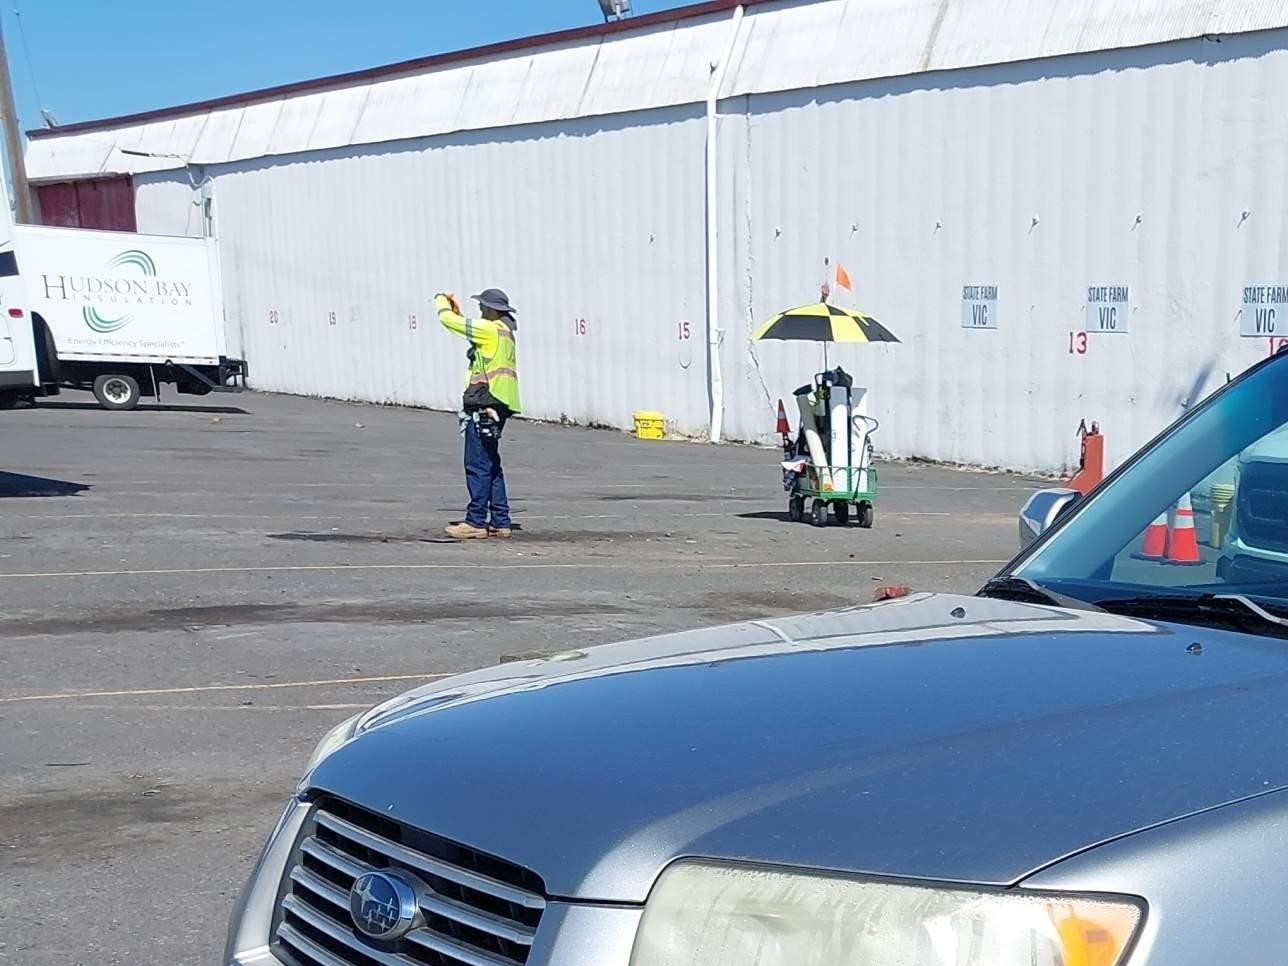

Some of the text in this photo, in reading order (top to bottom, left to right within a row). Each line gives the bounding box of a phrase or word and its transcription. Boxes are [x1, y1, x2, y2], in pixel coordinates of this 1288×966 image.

[41, 274, 191, 299] HUDSON BAY
[963, 285, 998, 300] STATE FARM
[1088, 286, 1128, 302] STATE FARM
[1243, 286, 1288, 304] STATE FARM
[73, 294, 192, 306] INSULATION
[269, 309, 279, 324] 20
[972, 303, 988, 326] VIC
[1099, 306, 1117, 330] VIC
[1255, 308, 1276, 333] VIC
[575, 318, 586, 335] 16
[678, 322, 691, 340] 15
[1069, 331, 1088, 355] 13
